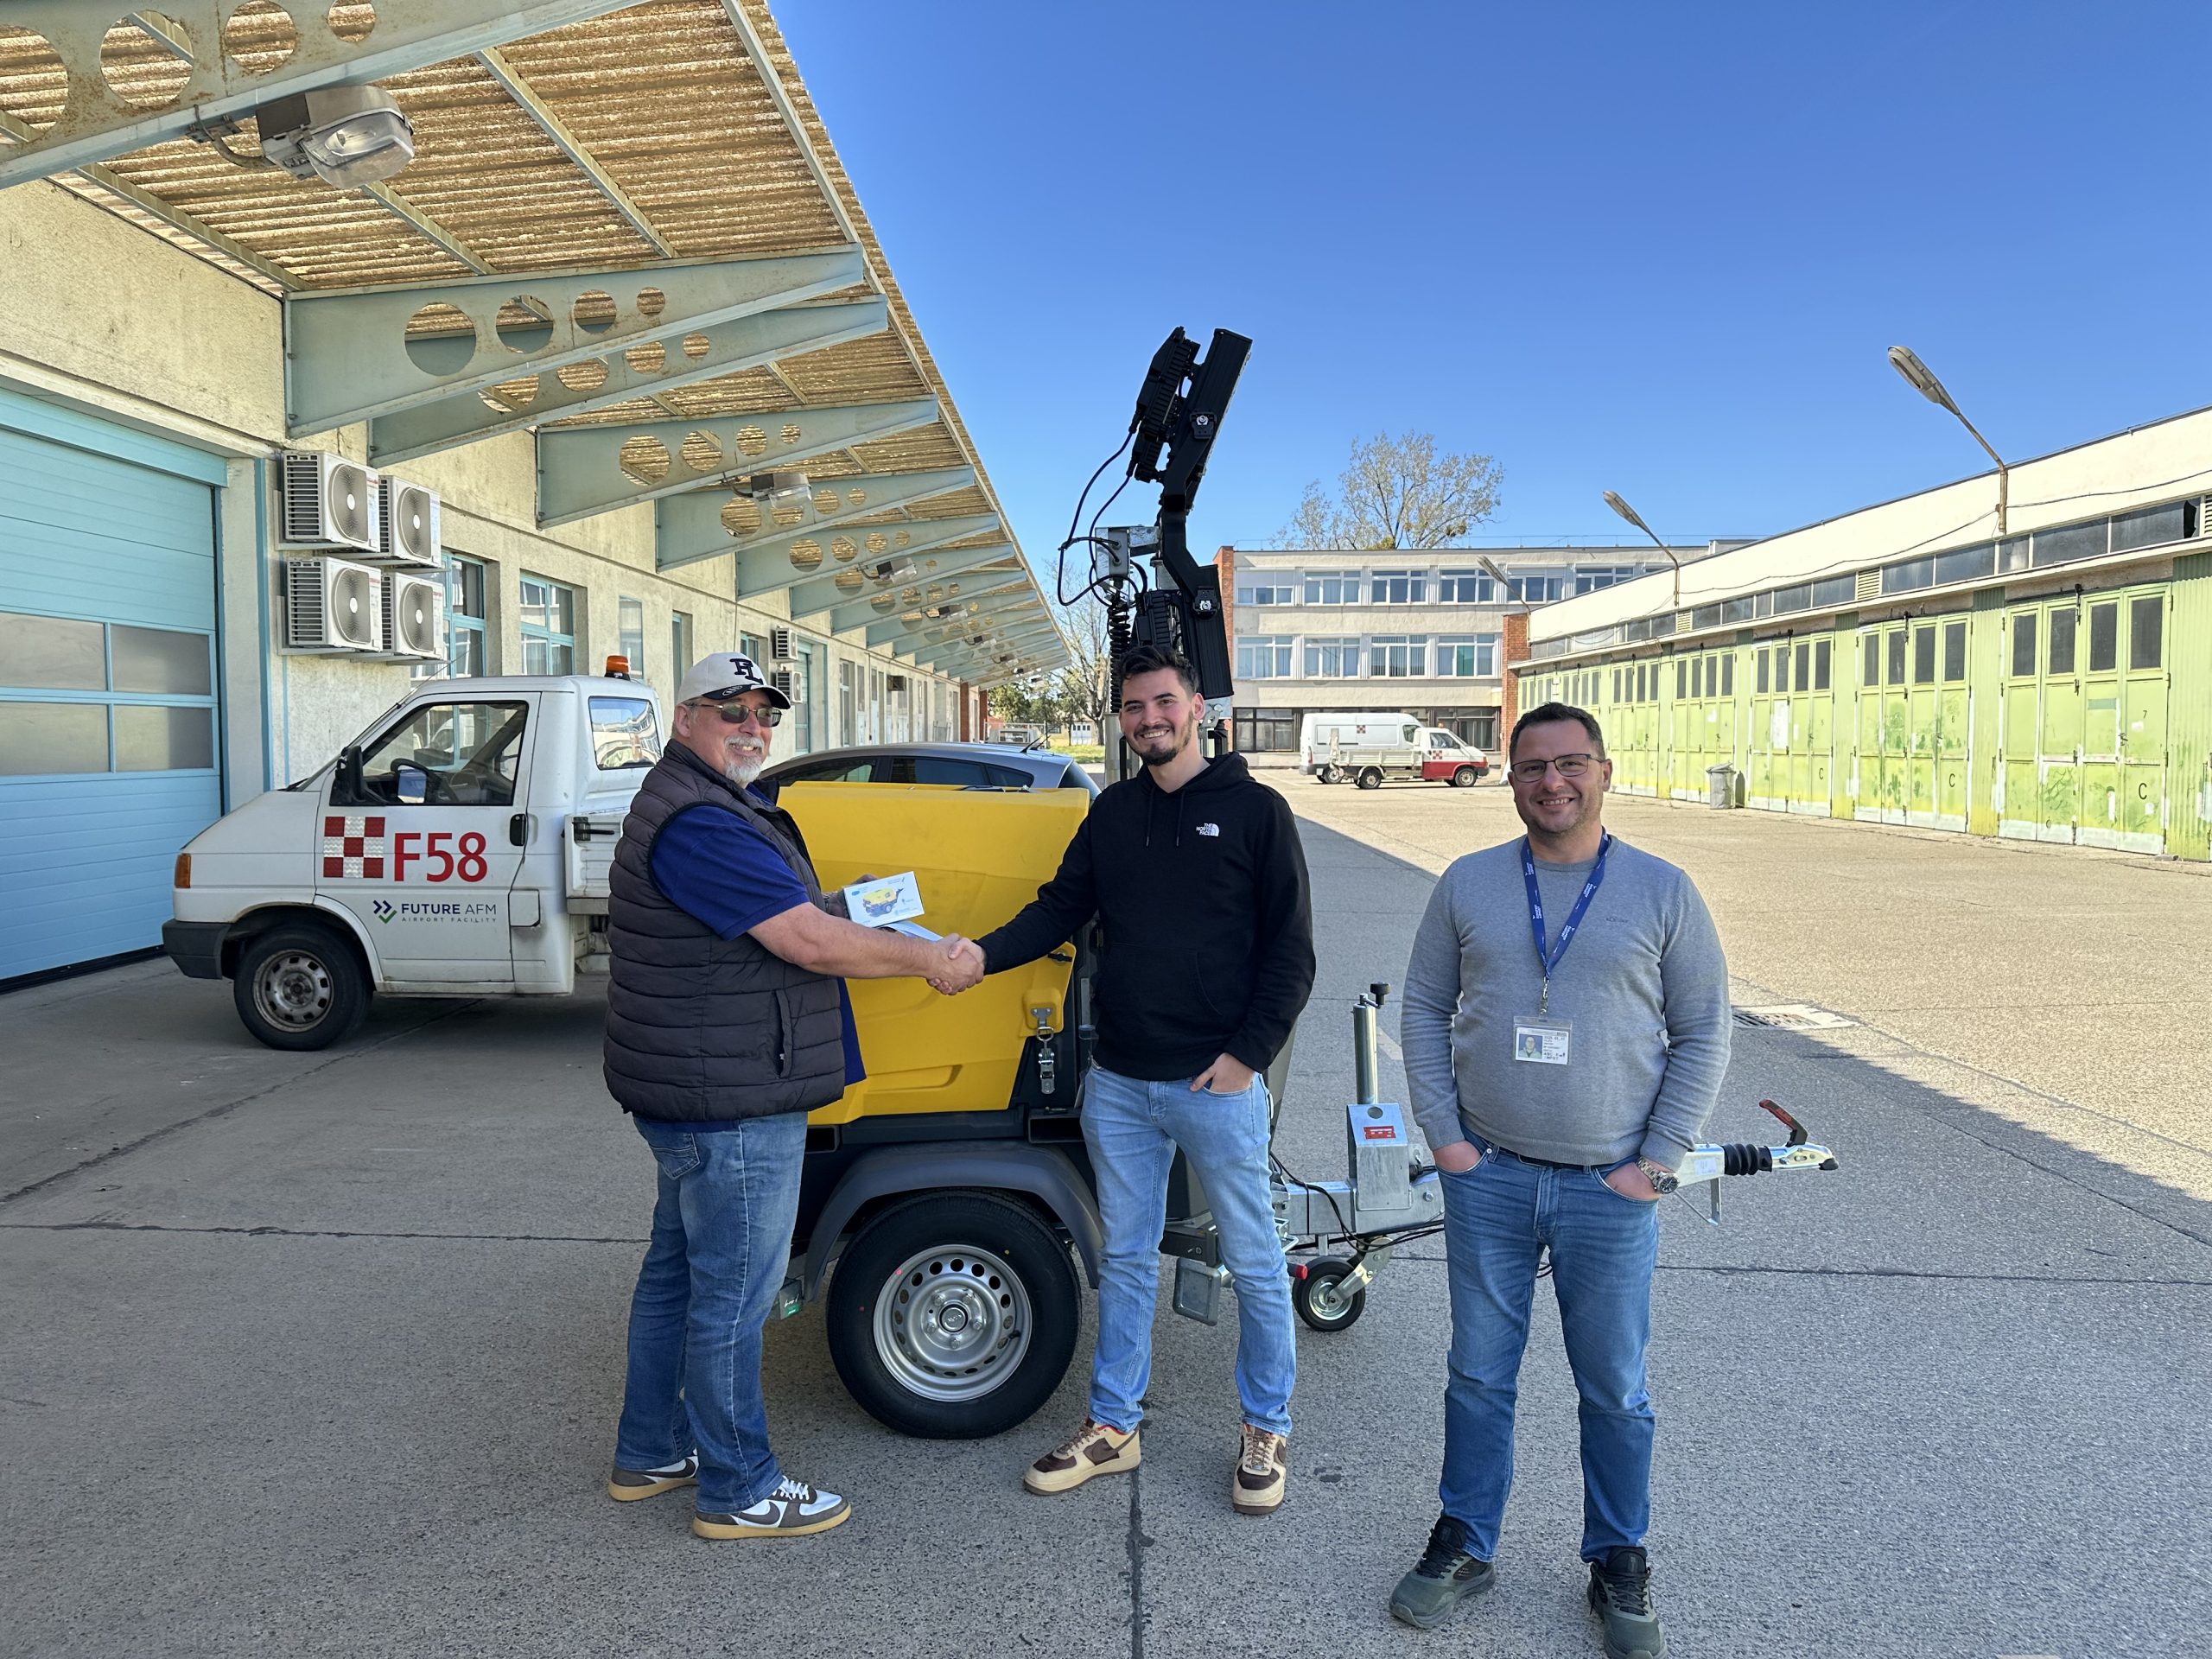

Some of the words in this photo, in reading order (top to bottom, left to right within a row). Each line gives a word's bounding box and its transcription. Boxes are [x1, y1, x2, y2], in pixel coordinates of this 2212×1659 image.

[2142, 709, 2148, 719] 7
[1818, 767, 1824, 780] C
[1948, 772, 1955, 788] C
[2138, 782, 2148, 800] C
[394, 831, 487, 882] F58
[401, 903, 461, 914] FUTURE
[465, 904, 497, 915] AFM
